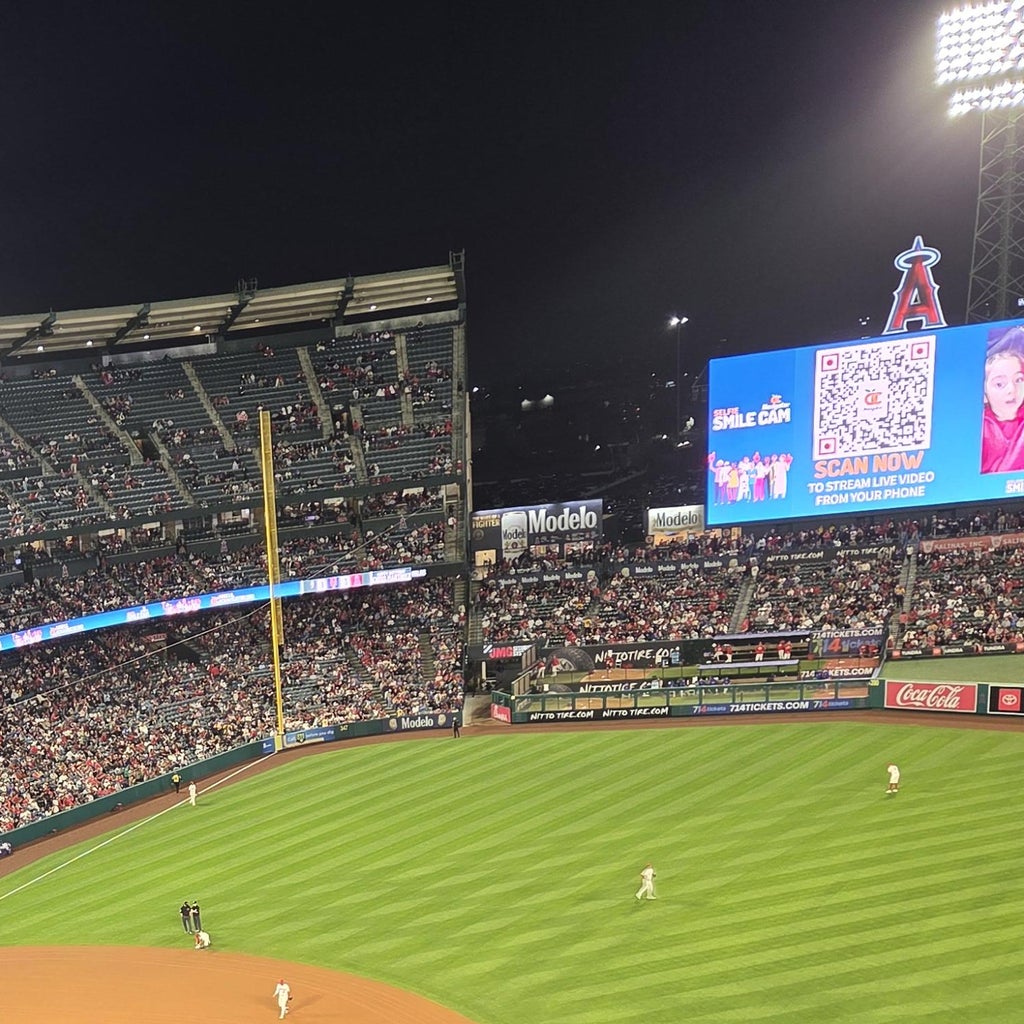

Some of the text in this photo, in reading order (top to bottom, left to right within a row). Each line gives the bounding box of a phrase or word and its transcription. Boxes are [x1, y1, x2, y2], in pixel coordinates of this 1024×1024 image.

[882, 235, 948, 335] A
[712, 407, 791, 431] SMILE CAM
[814, 450, 925, 479] SCAN NOW
[807, 471, 935, 494] TO STREAM LIVE VIDEO
[816, 486, 925, 506] FROM YOUR PHONE
[528, 505, 597, 534] Modelo
[656, 511, 698, 527] Modelo
[766, 553, 789, 562] NITTO
[812, 628, 883, 639] 714TICKETS.COM
[489, 646, 513, 659] JMG
[896, 683, 965, 709] Coca-Cola
[629, 707, 669, 716] TIRE.COM
[729, 701, 809, 712] 714TICKETS.COM
[401, 716, 434, 729] Modelo
[530, 710, 594, 720] NITTO TIRE.COM
